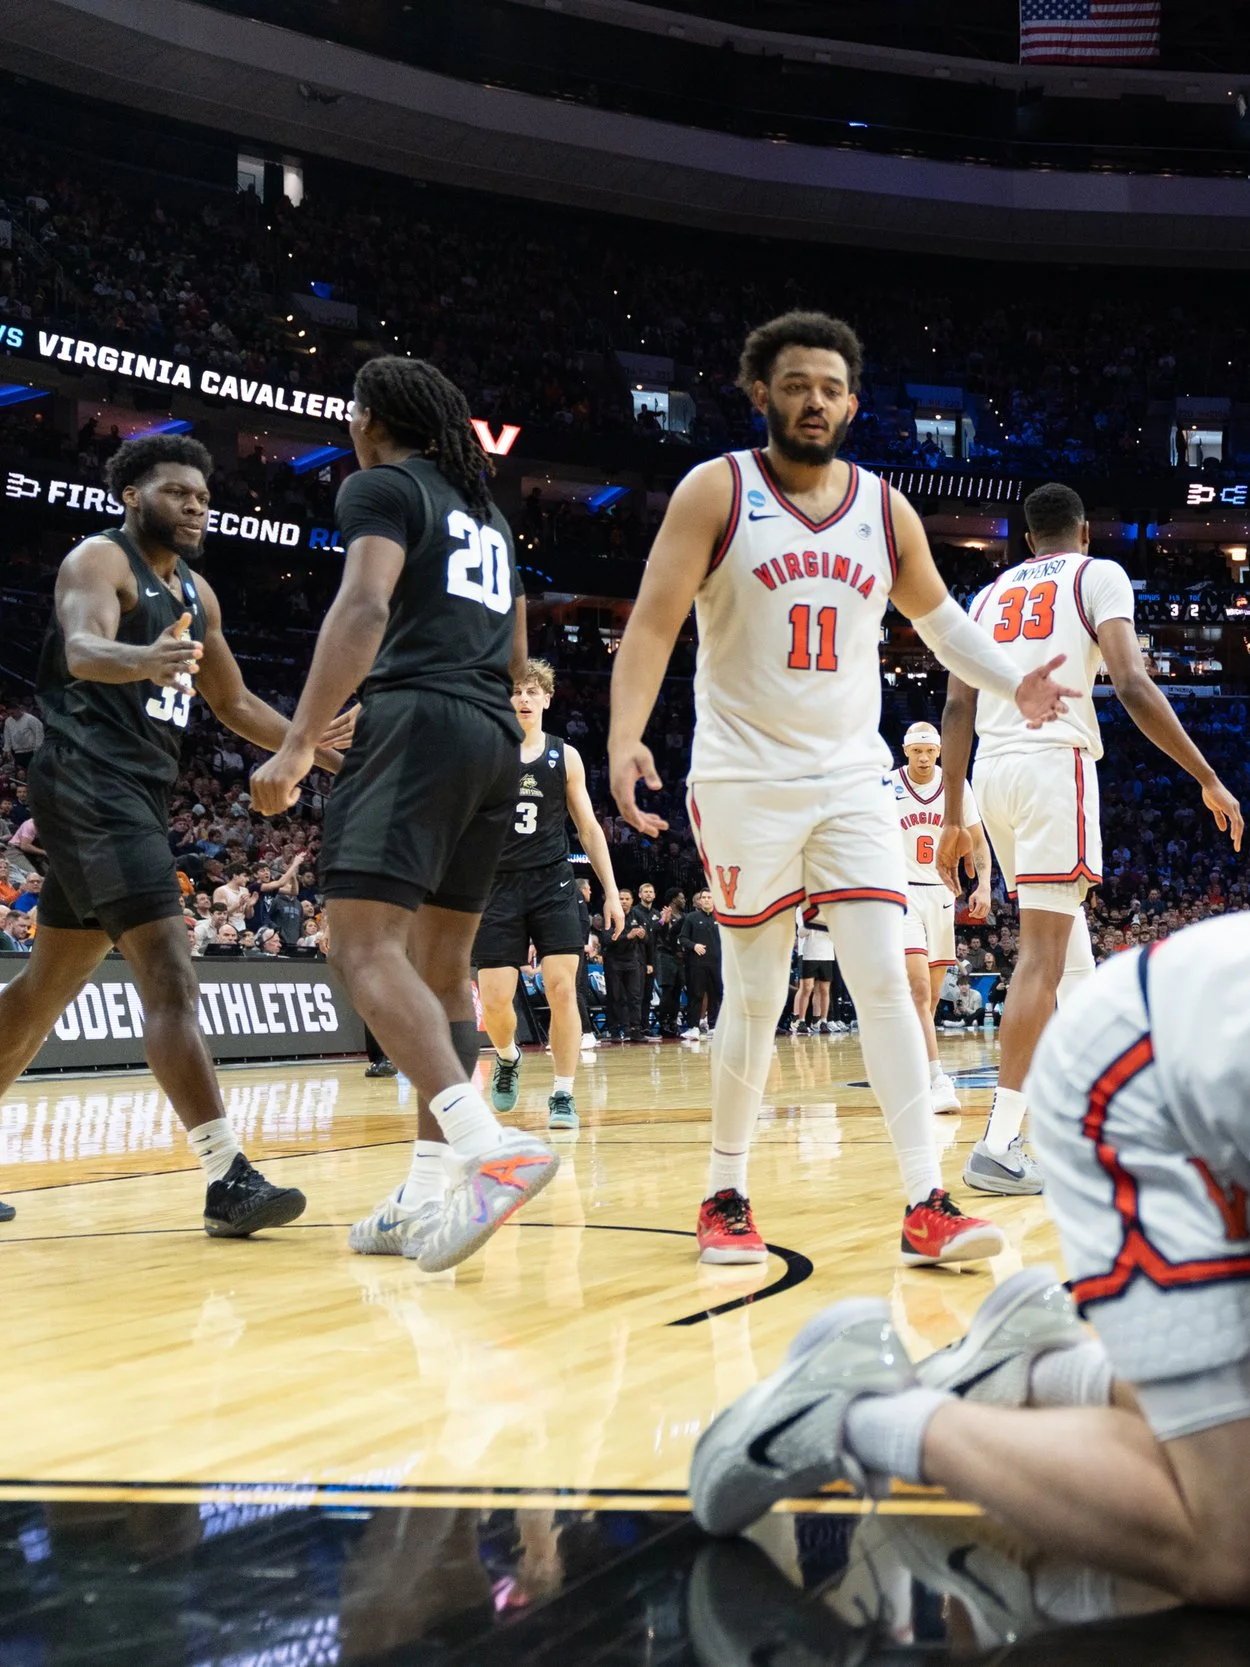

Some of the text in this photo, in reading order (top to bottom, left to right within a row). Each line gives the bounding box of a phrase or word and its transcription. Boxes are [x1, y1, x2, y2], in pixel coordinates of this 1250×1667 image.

[38, 330, 192, 389] VIRGINIA
[470, 418, 521, 455] V
[48, 480, 125, 515] FIRS
[207, 509, 300, 547] ECOND
[447, 510, 512, 615] 20
[752, 551, 876, 600] VIRGINIA
[993, 580, 1058, 644] 33
[1170, 604, 1199, 617] 3 2
[787, 603, 838, 672] 11
[514, 802, 538, 835] 3
[900, 811, 945, 831] VIRGIN
[916, 835, 934, 865] 6
[715, 864, 741, 910] V
